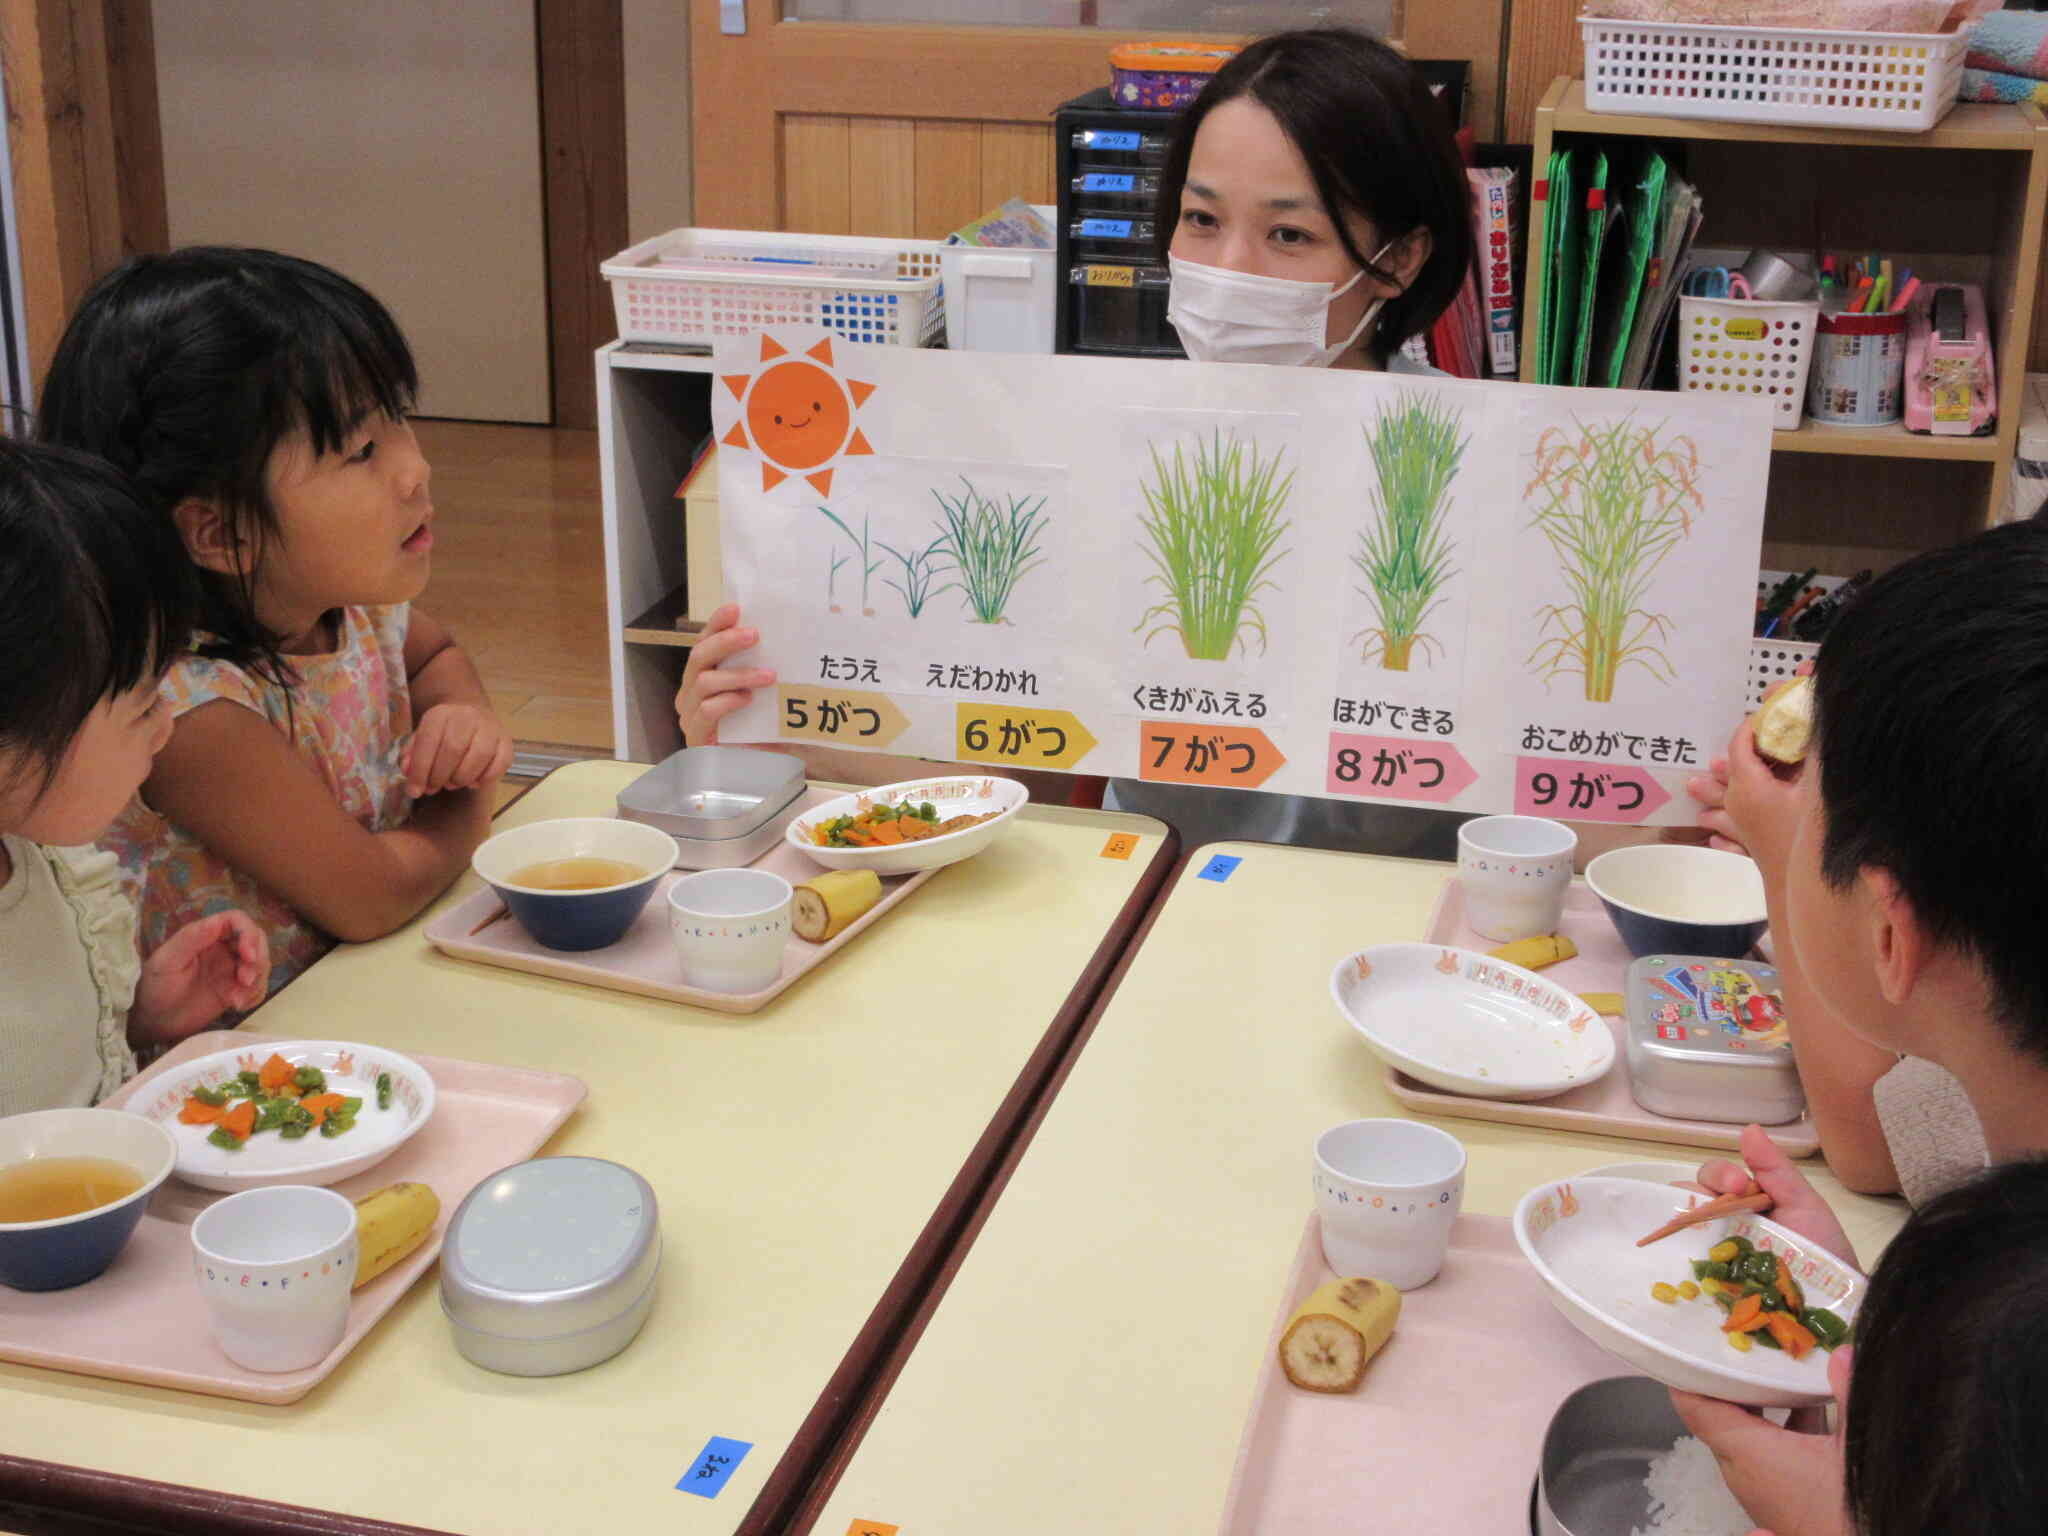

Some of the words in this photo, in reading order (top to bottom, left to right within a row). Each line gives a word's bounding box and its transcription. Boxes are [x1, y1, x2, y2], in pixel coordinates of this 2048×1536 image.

[820, 655, 881, 683] たうえ
[926, 663, 1039, 695] えだわかれ
[786, 698, 881, 736] 5がつ
[1133, 685, 1267, 718] くきがふえる
[1333, 698, 1454, 735] ほができる
[964, 718, 1066, 757] 6がつ
[1151, 735, 1256, 774] 7がつ
[1521, 724, 1697, 764] おこめができた
[1335, 748, 1445, 788] 8がつ
[1531, 771, 1645, 811] 9がつ
